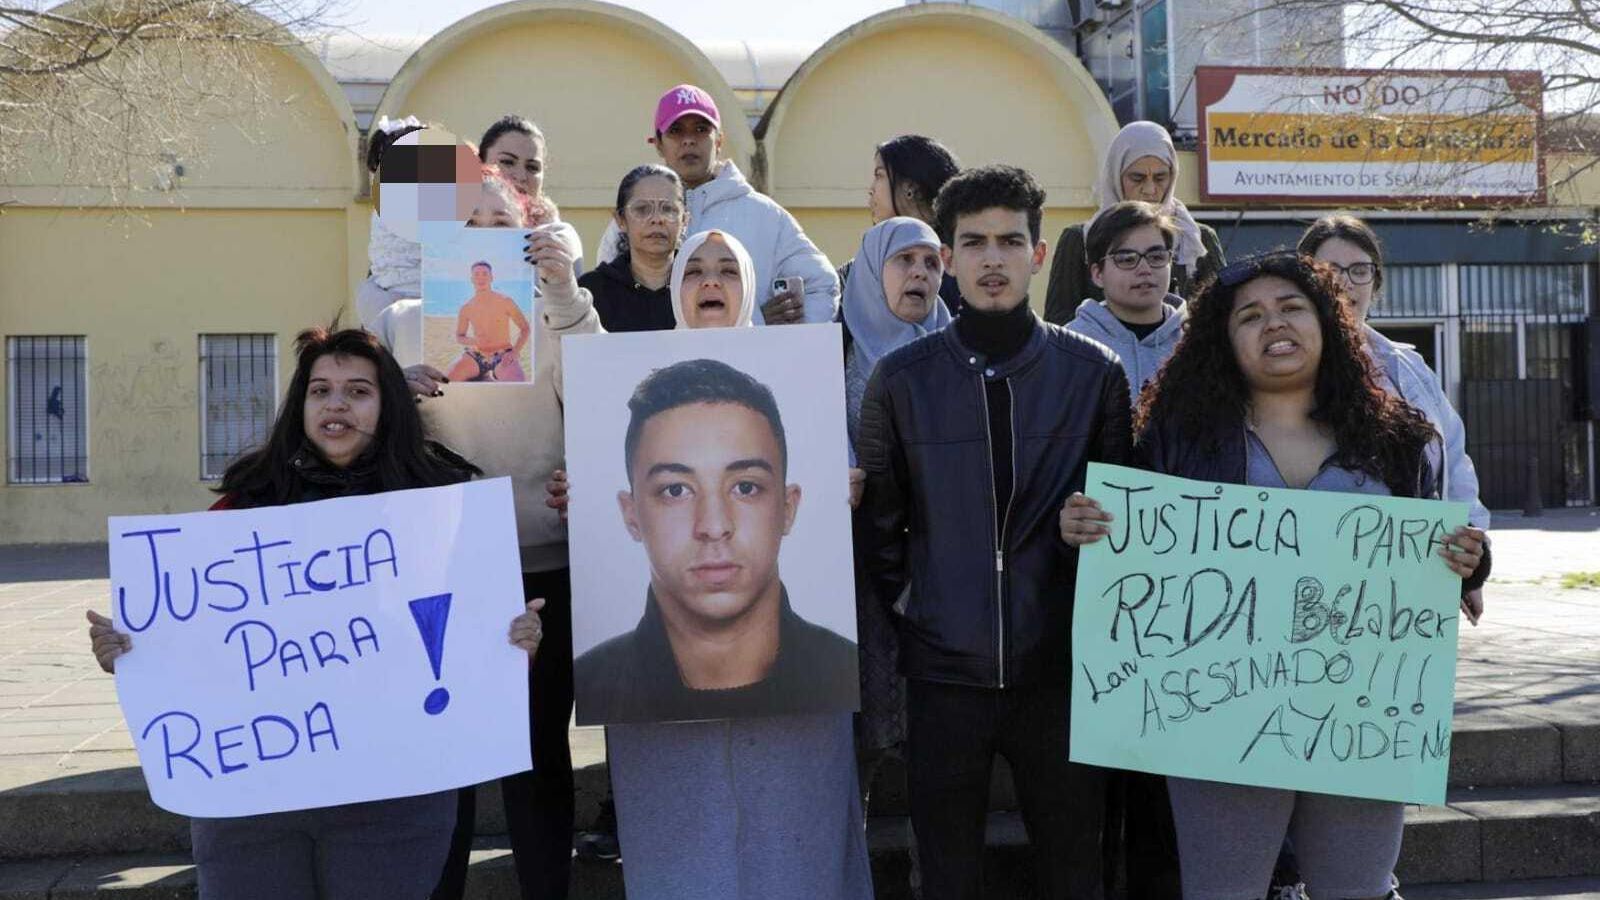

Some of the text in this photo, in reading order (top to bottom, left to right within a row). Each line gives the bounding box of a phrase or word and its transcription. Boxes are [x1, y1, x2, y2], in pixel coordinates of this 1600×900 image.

[1323, 85, 1420, 105] NO DO
[1213, 127, 1532, 149] Mercado de la Cadearia
[1234, 171, 1356, 187] AYUNTAMIENTO
[1359, 173, 1380, 187] DE
[1102, 484, 1301, 557] JUSTICIA
[119, 528, 398, 632] JUSTICIA
[224, 616, 380, 691] PARA
[142, 701, 340, 780] REDA
